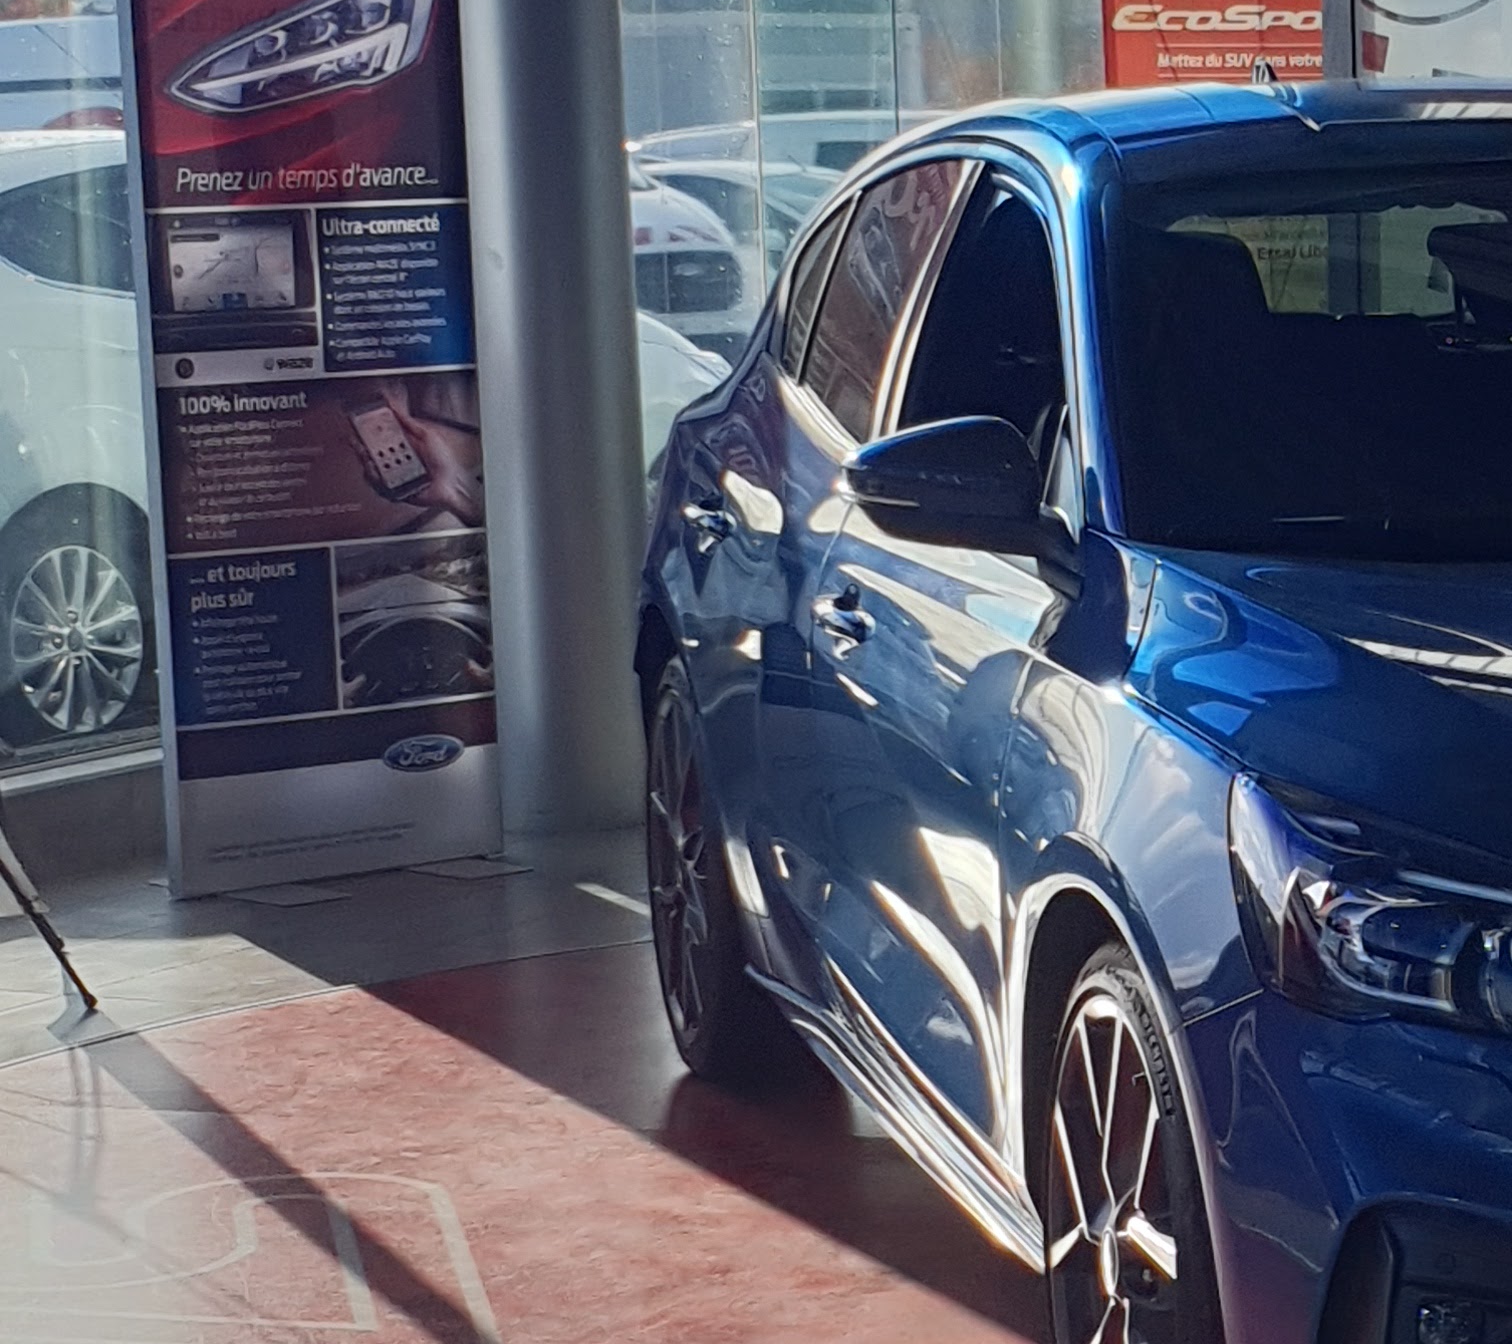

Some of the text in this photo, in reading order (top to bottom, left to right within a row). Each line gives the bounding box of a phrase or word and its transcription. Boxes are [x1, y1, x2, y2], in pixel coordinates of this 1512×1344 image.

[1224, 52, 1253, 68] SUV
[176, 167, 243, 192] Prenez
[248, 169, 273, 189] un
[277, 167, 337, 191] temps
[322, 212, 440, 236] Ultra-connecté
[179, 391, 307, 415] 100% innovant
[207, 567, 227, 583] et
[228, 561, 297, 583] toujours
[191, 590, 227, 613] plus
